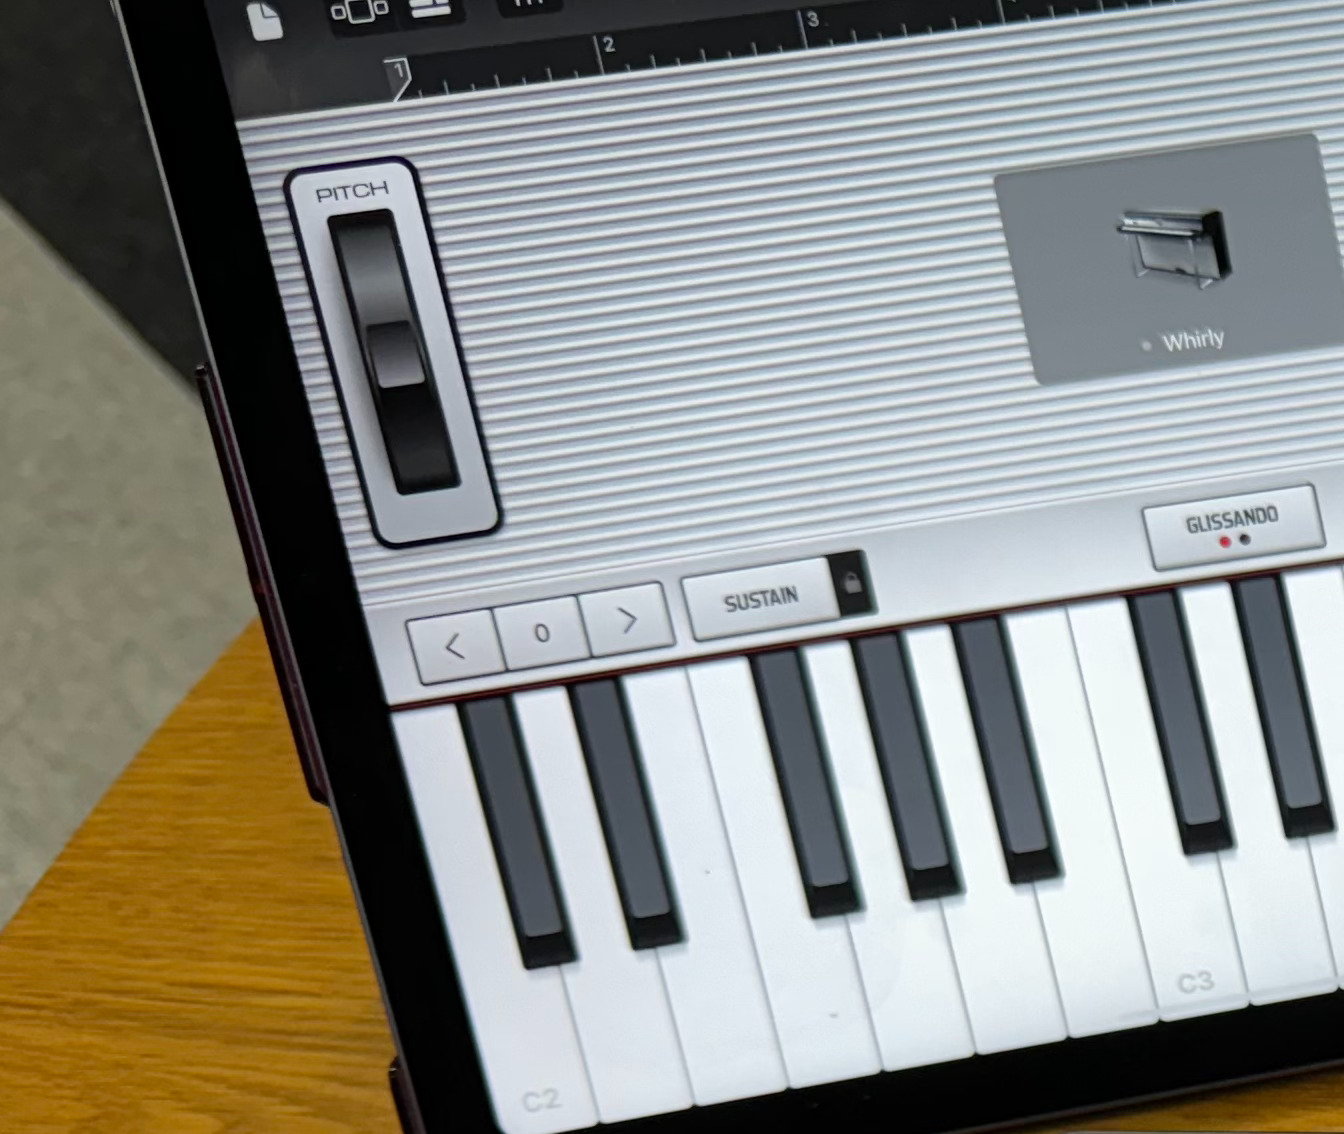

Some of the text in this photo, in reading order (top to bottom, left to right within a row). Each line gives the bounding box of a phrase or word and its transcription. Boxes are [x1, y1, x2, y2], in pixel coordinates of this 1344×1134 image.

[808, 11, 820, 28] 3
[603, 36, 615, 53] 2
[316, 180, 390, 203] PITCH
[1163, 329, 1225, 352] Whirly
[1186, 505, 1280, 534] GLISSANDO
[723, 585, 800, 613] SUSTAIN
[1177, 970, 1216, 995] C3
[521, 1087, 563, 1113] C2
